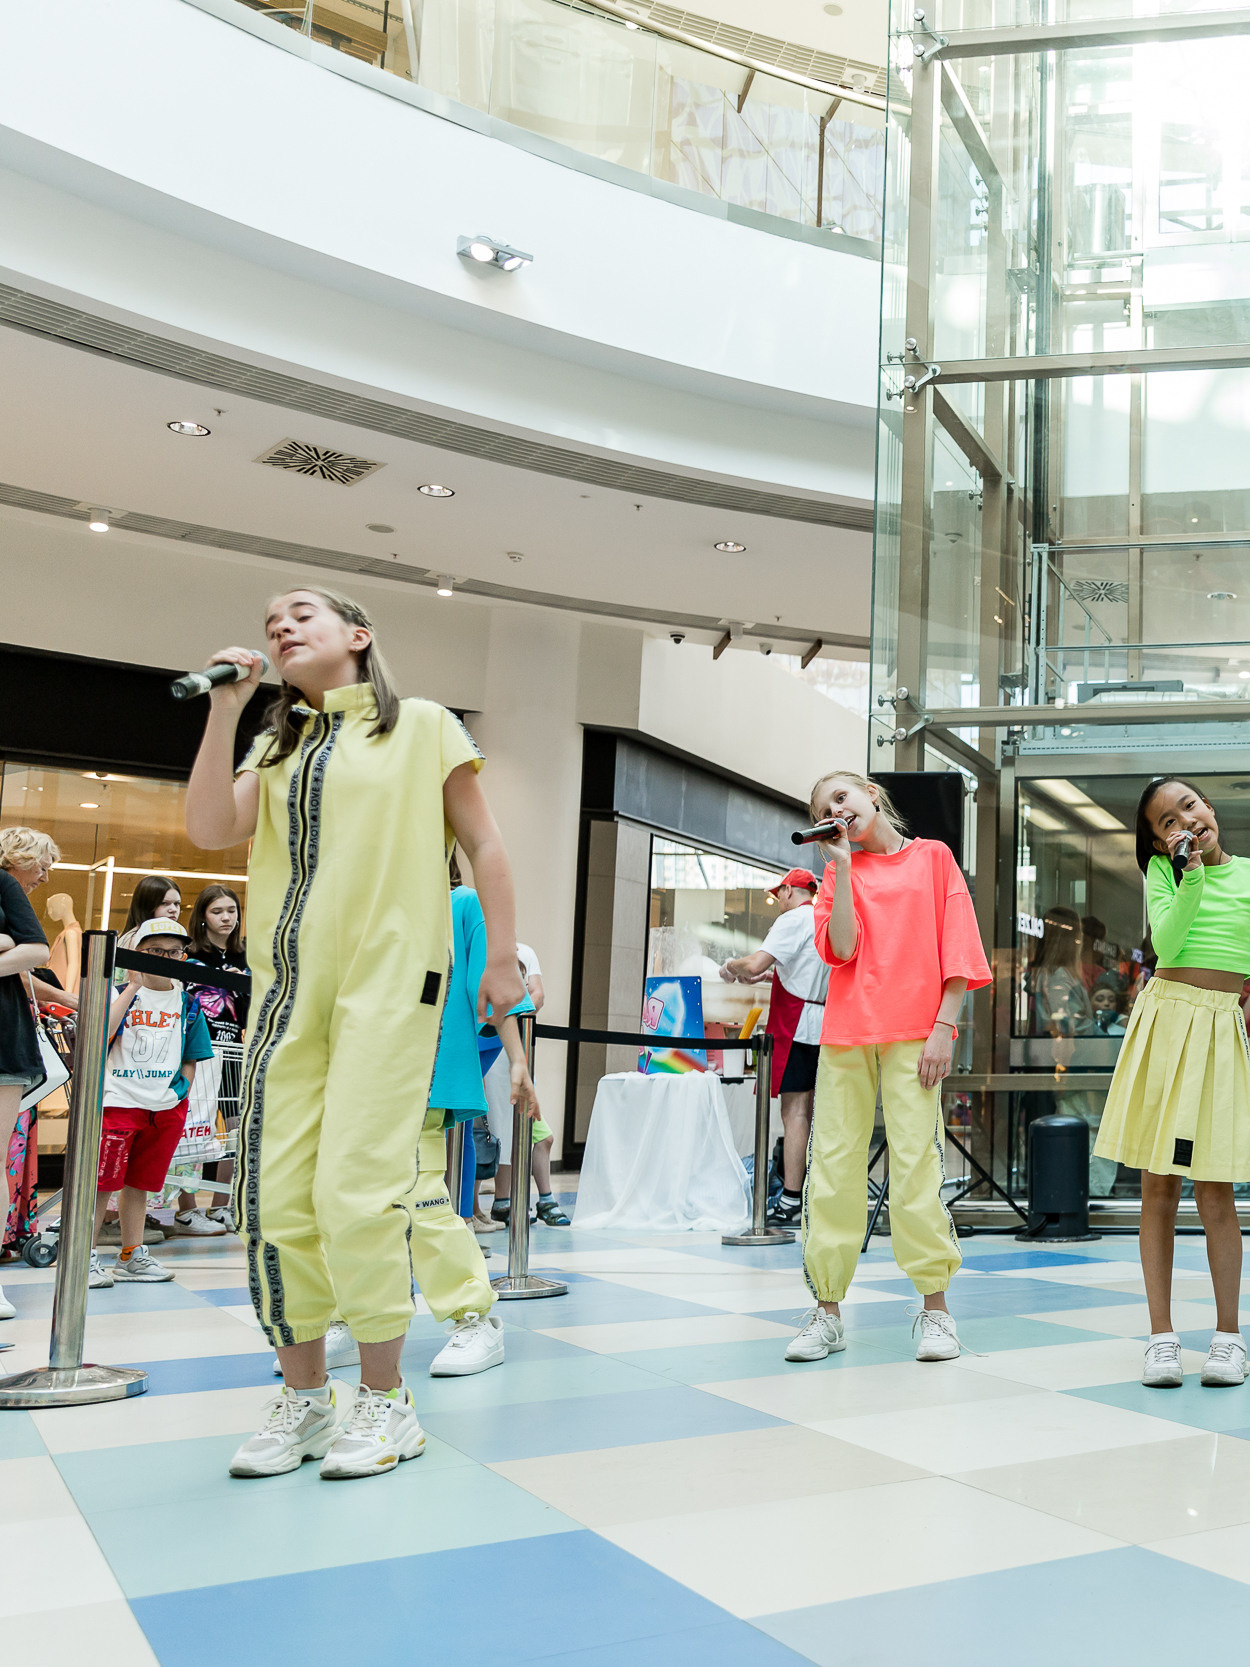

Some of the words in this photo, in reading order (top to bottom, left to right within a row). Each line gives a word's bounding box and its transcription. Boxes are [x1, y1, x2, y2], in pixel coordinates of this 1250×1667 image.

[315, 751, 329, 773] LOVE
[289, 774, 299, 798] LOVE
[311, 788, 319, 811] LOVE
[290, 812, 298, 839] LOVE
[310, 825, 318, 850] LOVE
[290, 851, 298, 875] LOVE
[283, 887, 295, 910] LOVE
[294, 900, 305, 923] LOVE
[289, 938, 297, 963] LOVE
[289, 977, 297, 1000] LOVE
[260, 998, 273, 1022] LOVE
[276, 1014, 288, 1037] LOVE
[132, 1029, 173, 1063] 07
[248, 1035, 260, 1059] LOVE
[259, 1050, 271, 1073] LOVE
[254, 1090, 262, 1114] LOVE
[249, 1129, 259, 1153] LOVE
[248, 1169, 258, 1194] LOVE
[422, 1198, 445, 1208] WANG
[248, 1209, 258, 1233] LOVE
[268, 1264, 280, 1286] LOVE
[272, 1298, 282, 1322] LOVE
